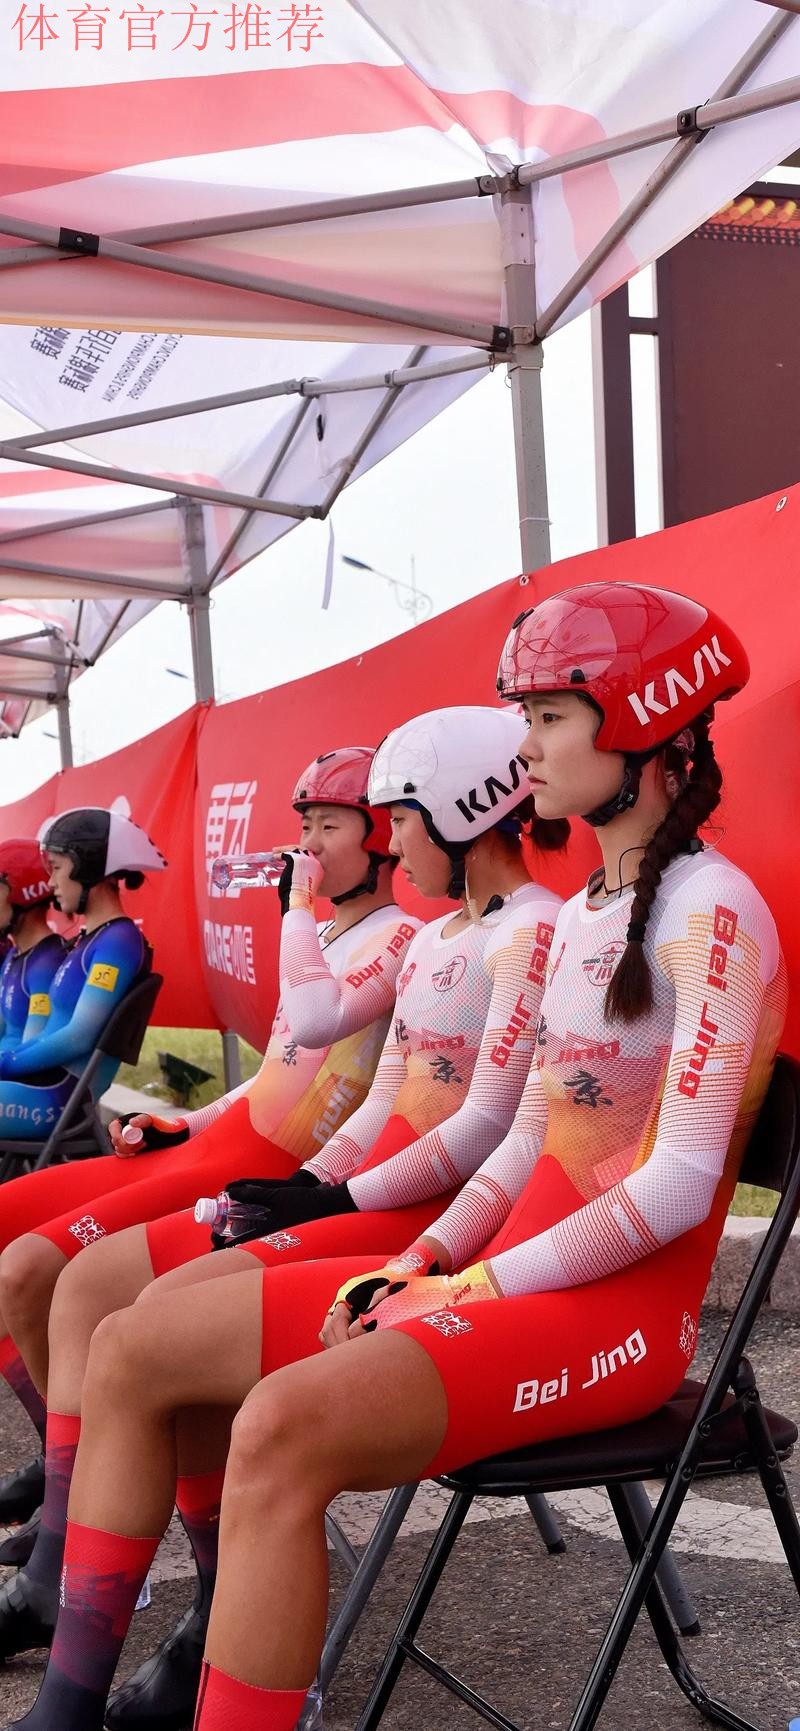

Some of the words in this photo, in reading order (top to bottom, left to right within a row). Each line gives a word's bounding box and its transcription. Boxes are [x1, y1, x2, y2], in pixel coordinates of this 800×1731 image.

[627, 634, 732, 726] KASK
[22, 881, 51, 900] KA
[345, 956, 384, 989] Jing
[386, 923, 416, 958] Bei
[527, 921, 556, 987] Bei
[706, 903, 739, 993] Bei
[490, 992, 532, 1069] Jing
[677, 1001, 719, 1100] Jing
[563, 1069, 614, 1108] 京
[512, 1367, 568, 1413] Bei
[582, 1328, 647, 1390] Jing
